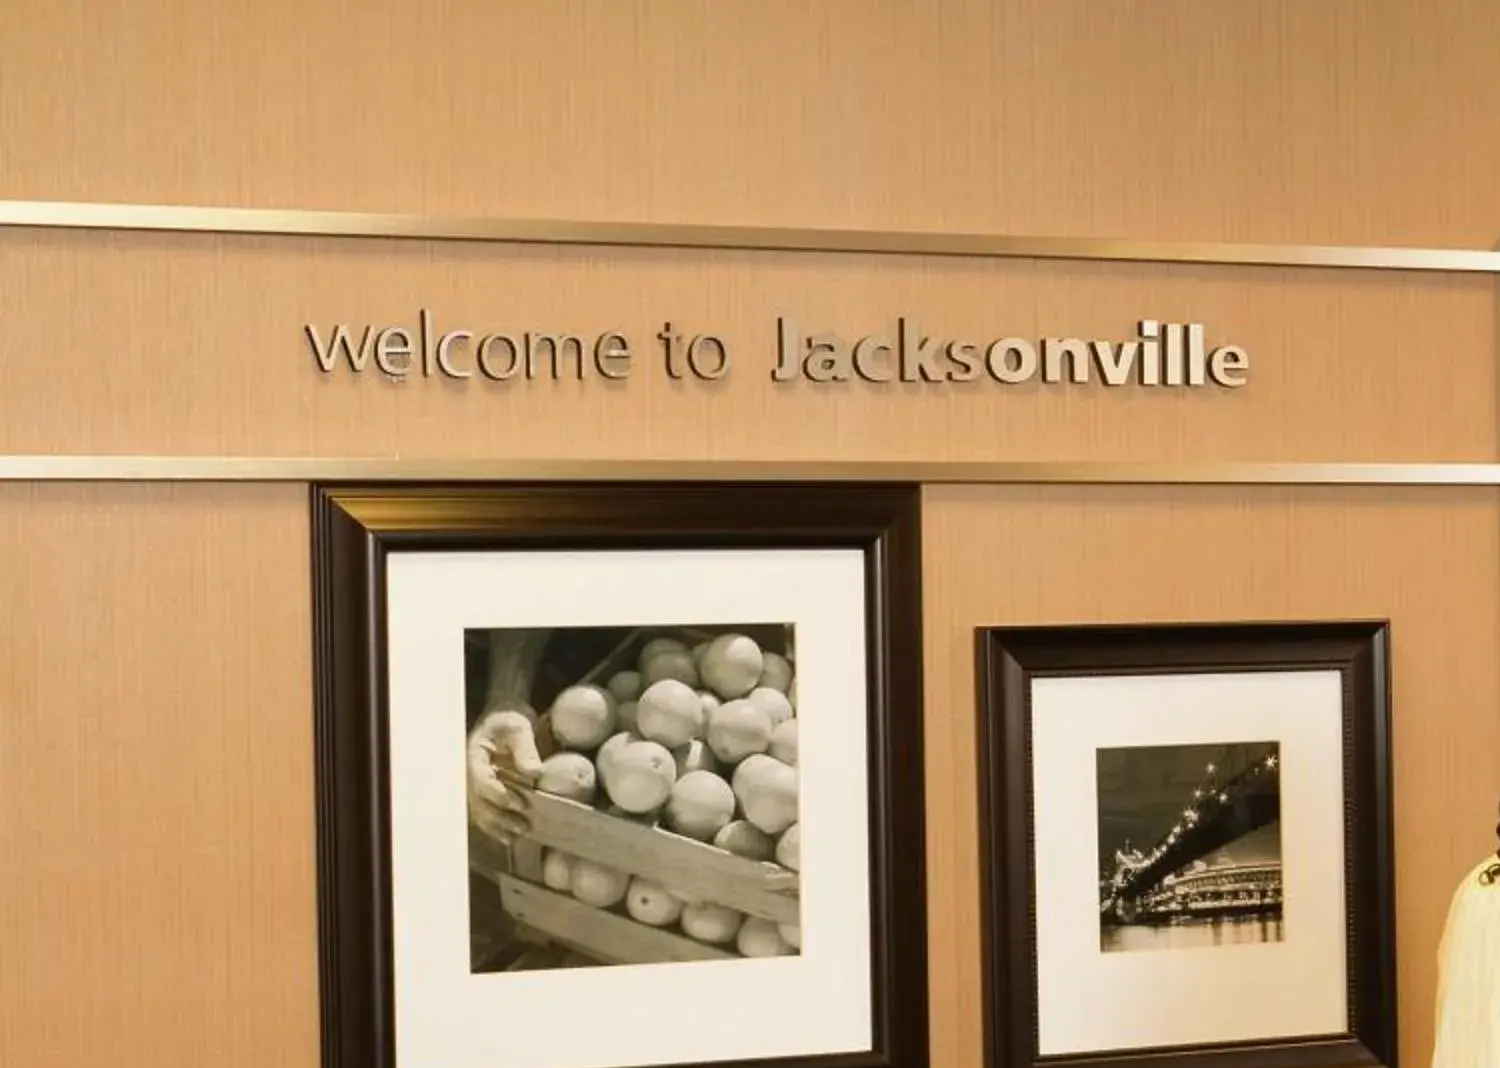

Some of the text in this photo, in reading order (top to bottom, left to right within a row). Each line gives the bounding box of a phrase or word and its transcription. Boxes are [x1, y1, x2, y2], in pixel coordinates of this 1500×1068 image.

[304, 308, 1250, 388] welcome to Jacksonville
